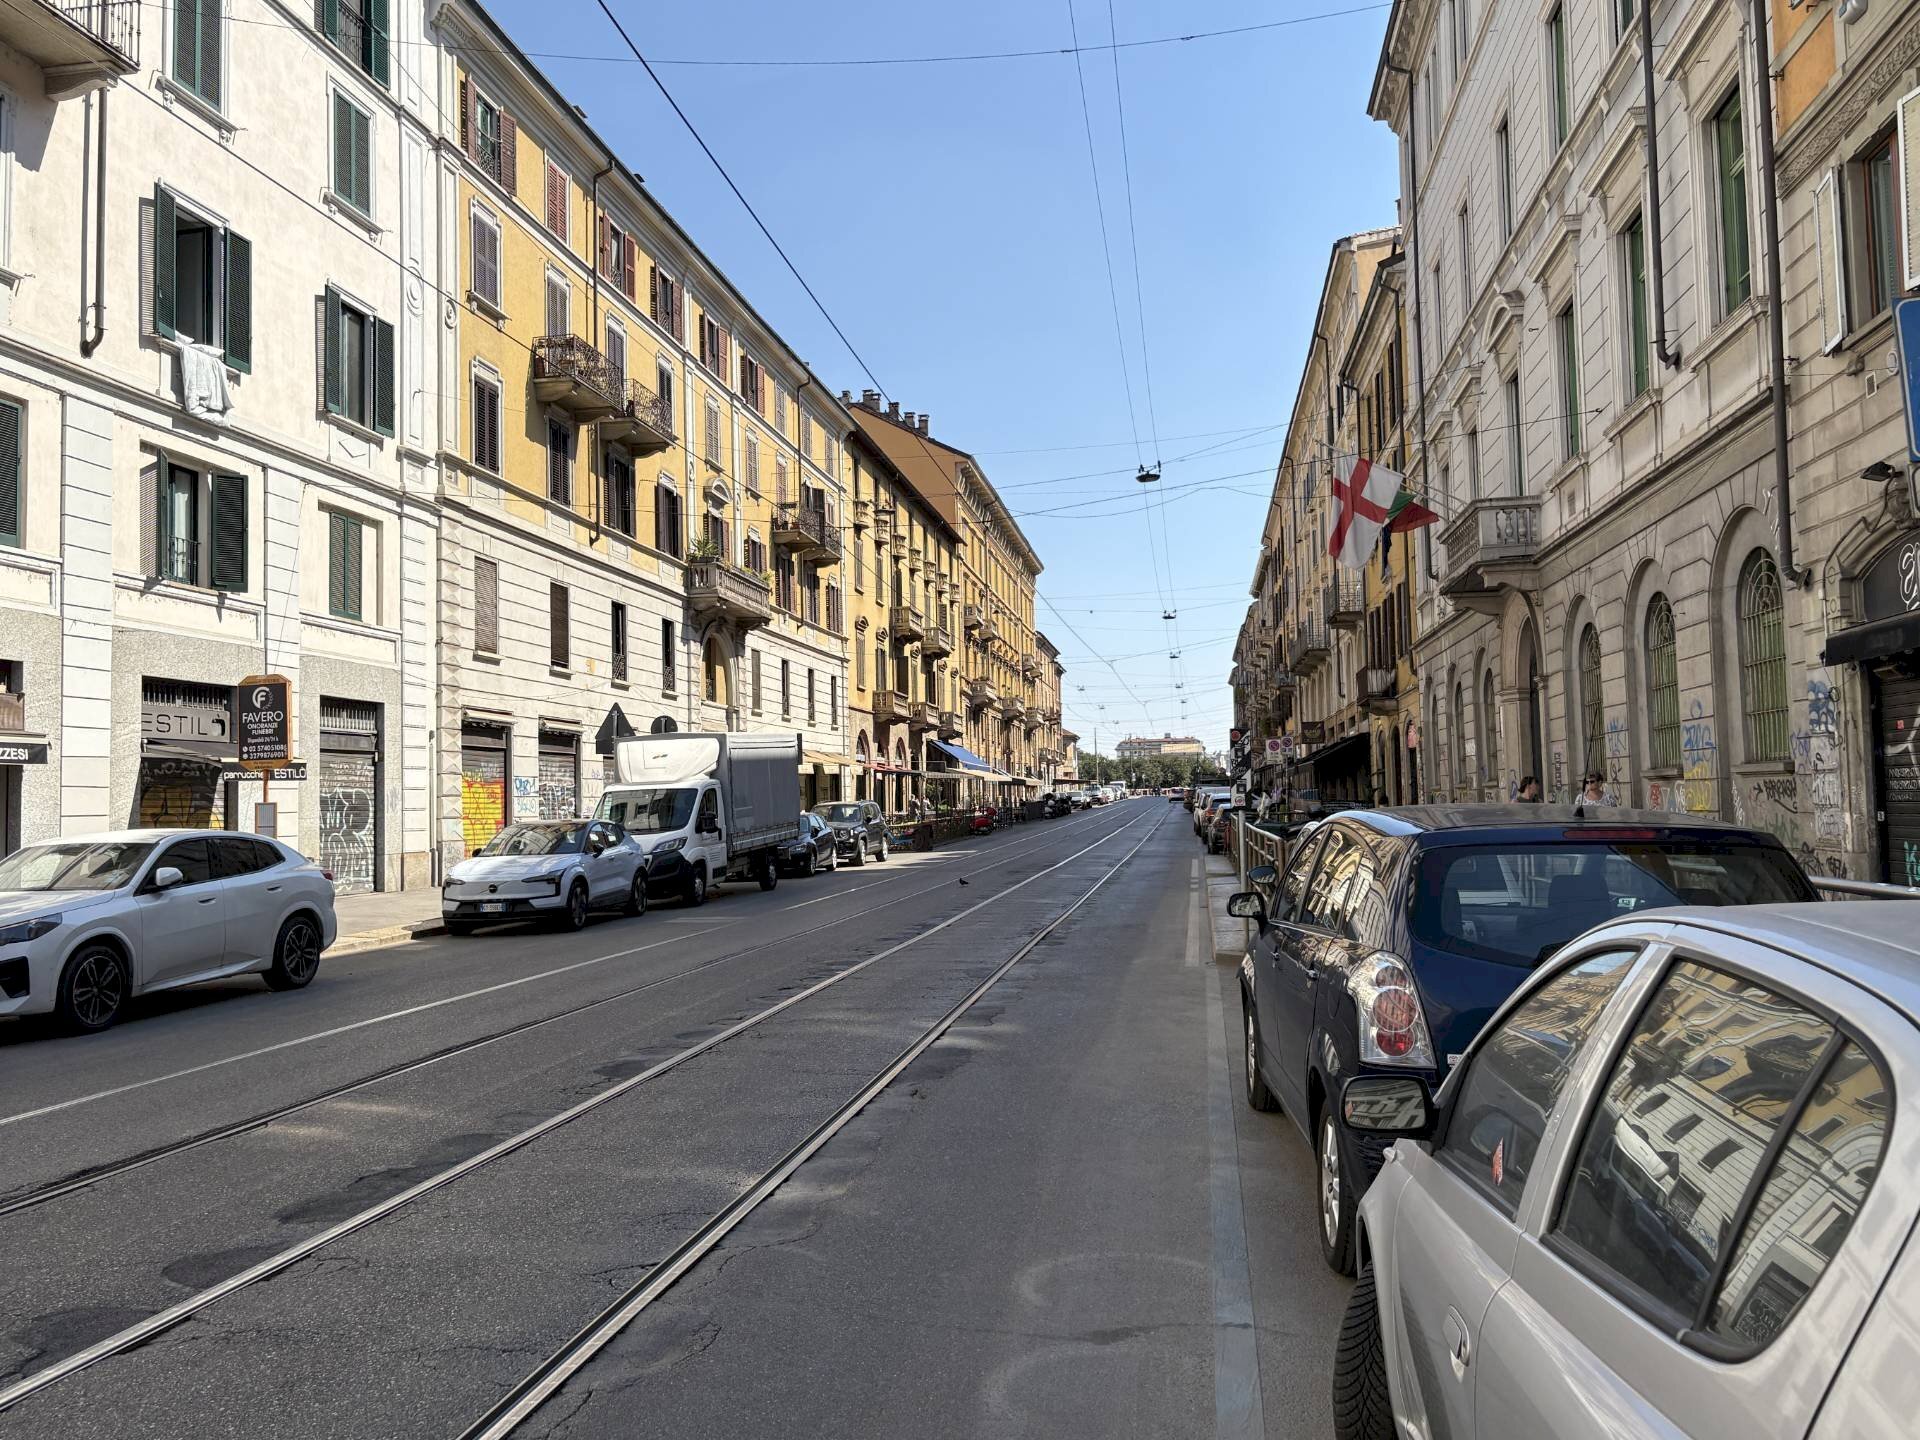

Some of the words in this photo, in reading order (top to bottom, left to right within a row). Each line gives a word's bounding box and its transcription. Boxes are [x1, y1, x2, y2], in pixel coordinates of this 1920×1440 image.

[242, 711, 284, 723] FAVERO
[247, 722, 279, 730] ONORANZE
[274, 767, 307, 779] ESTILÒ
